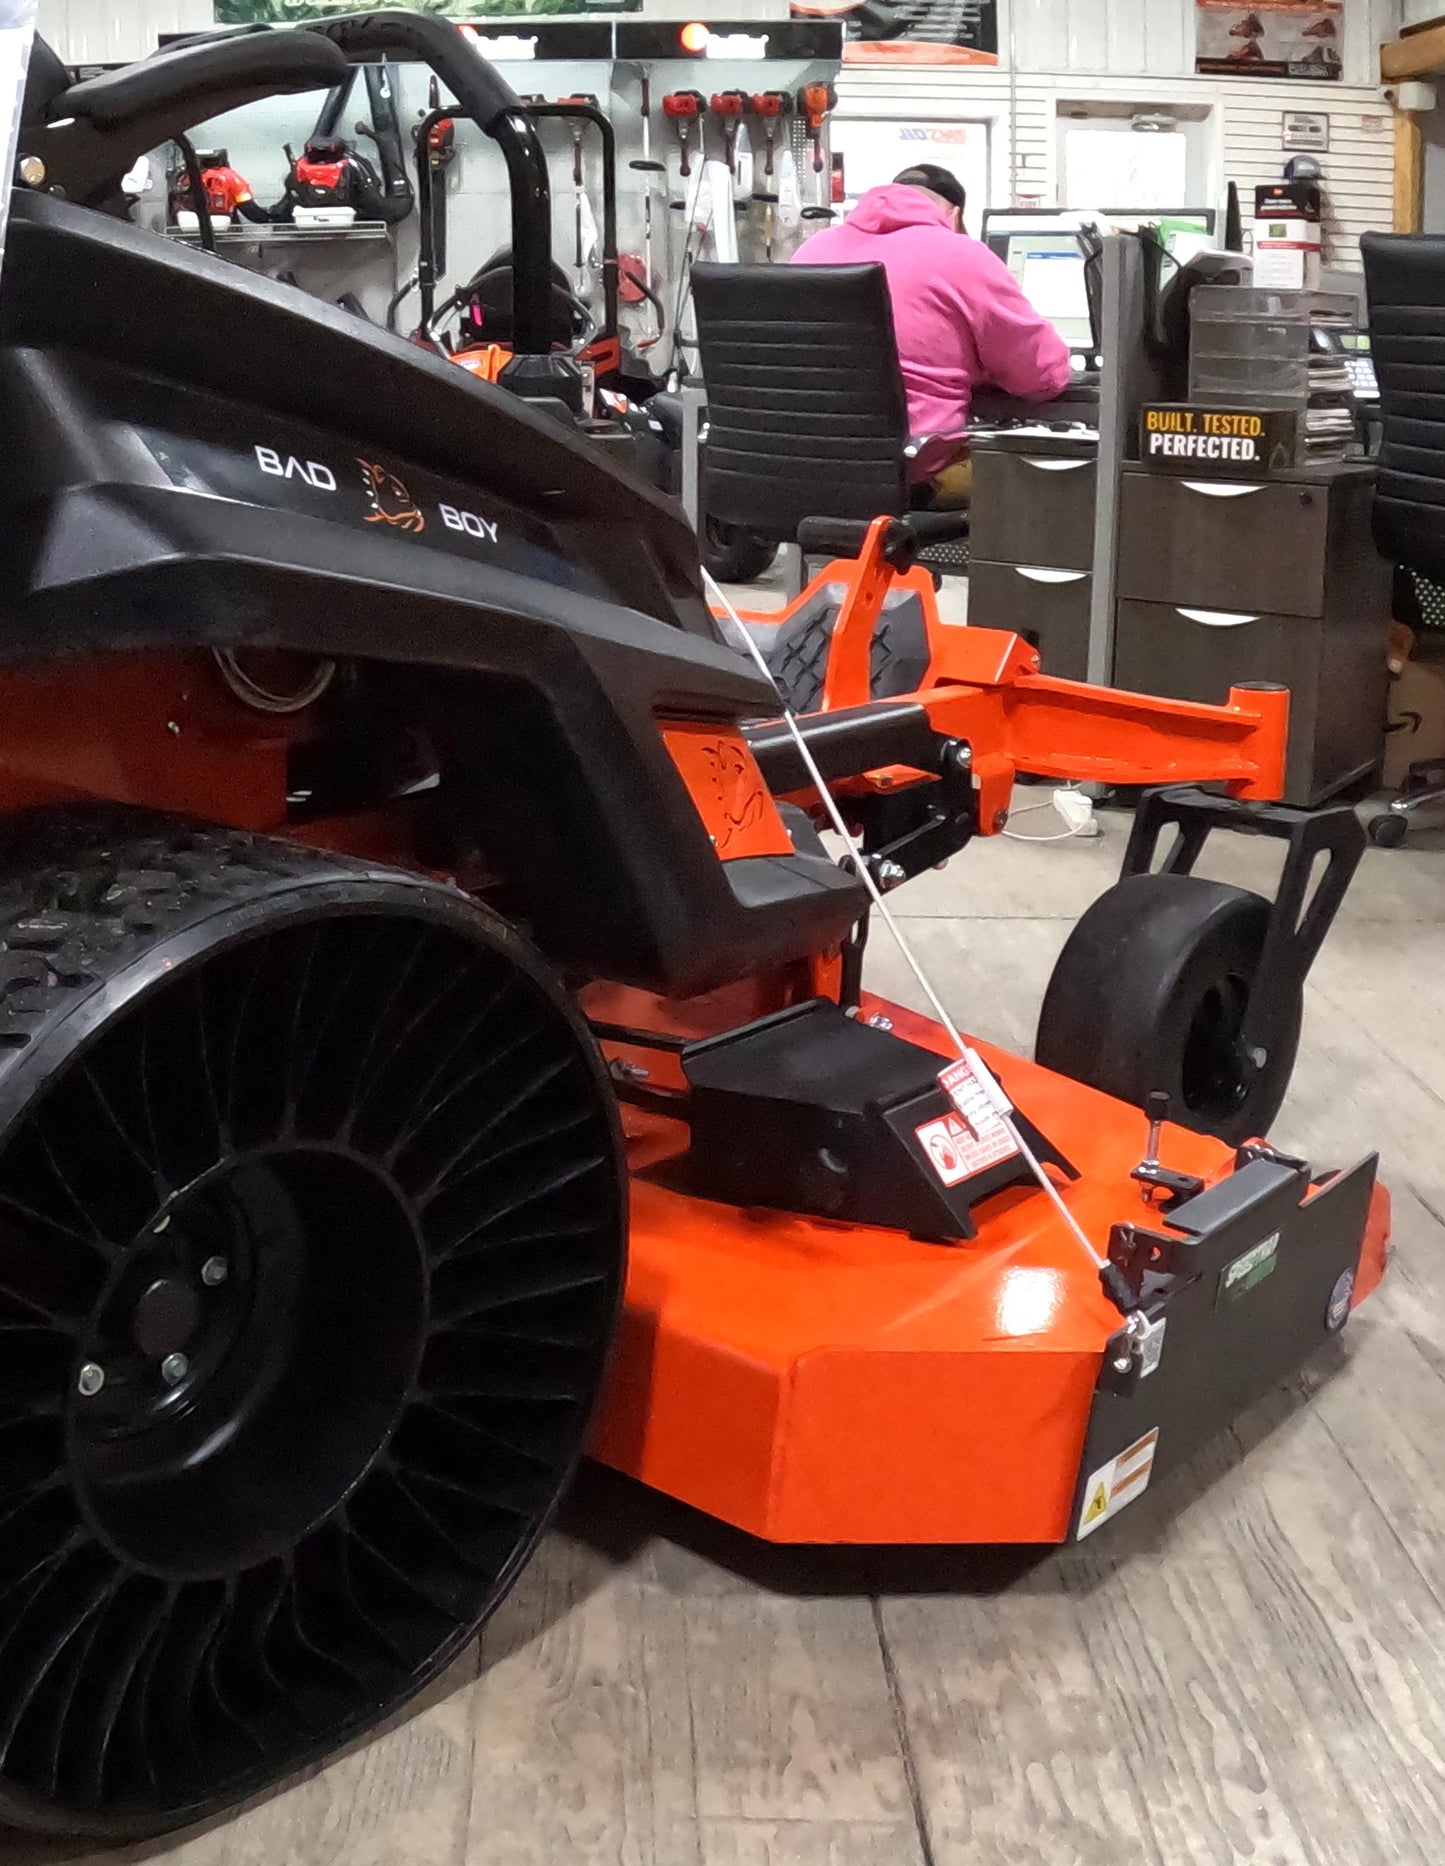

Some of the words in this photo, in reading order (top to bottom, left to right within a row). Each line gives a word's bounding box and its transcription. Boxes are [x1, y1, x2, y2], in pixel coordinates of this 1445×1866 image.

[1147, 411, 1197, 433] BUILT.
[1202, 413, 1266, 437] TESTED.
[1149, 433, 1260, 461] PERFECTED.
[254, 445, 337, 491] BAD
[438, 503, 498, 543] BOY
